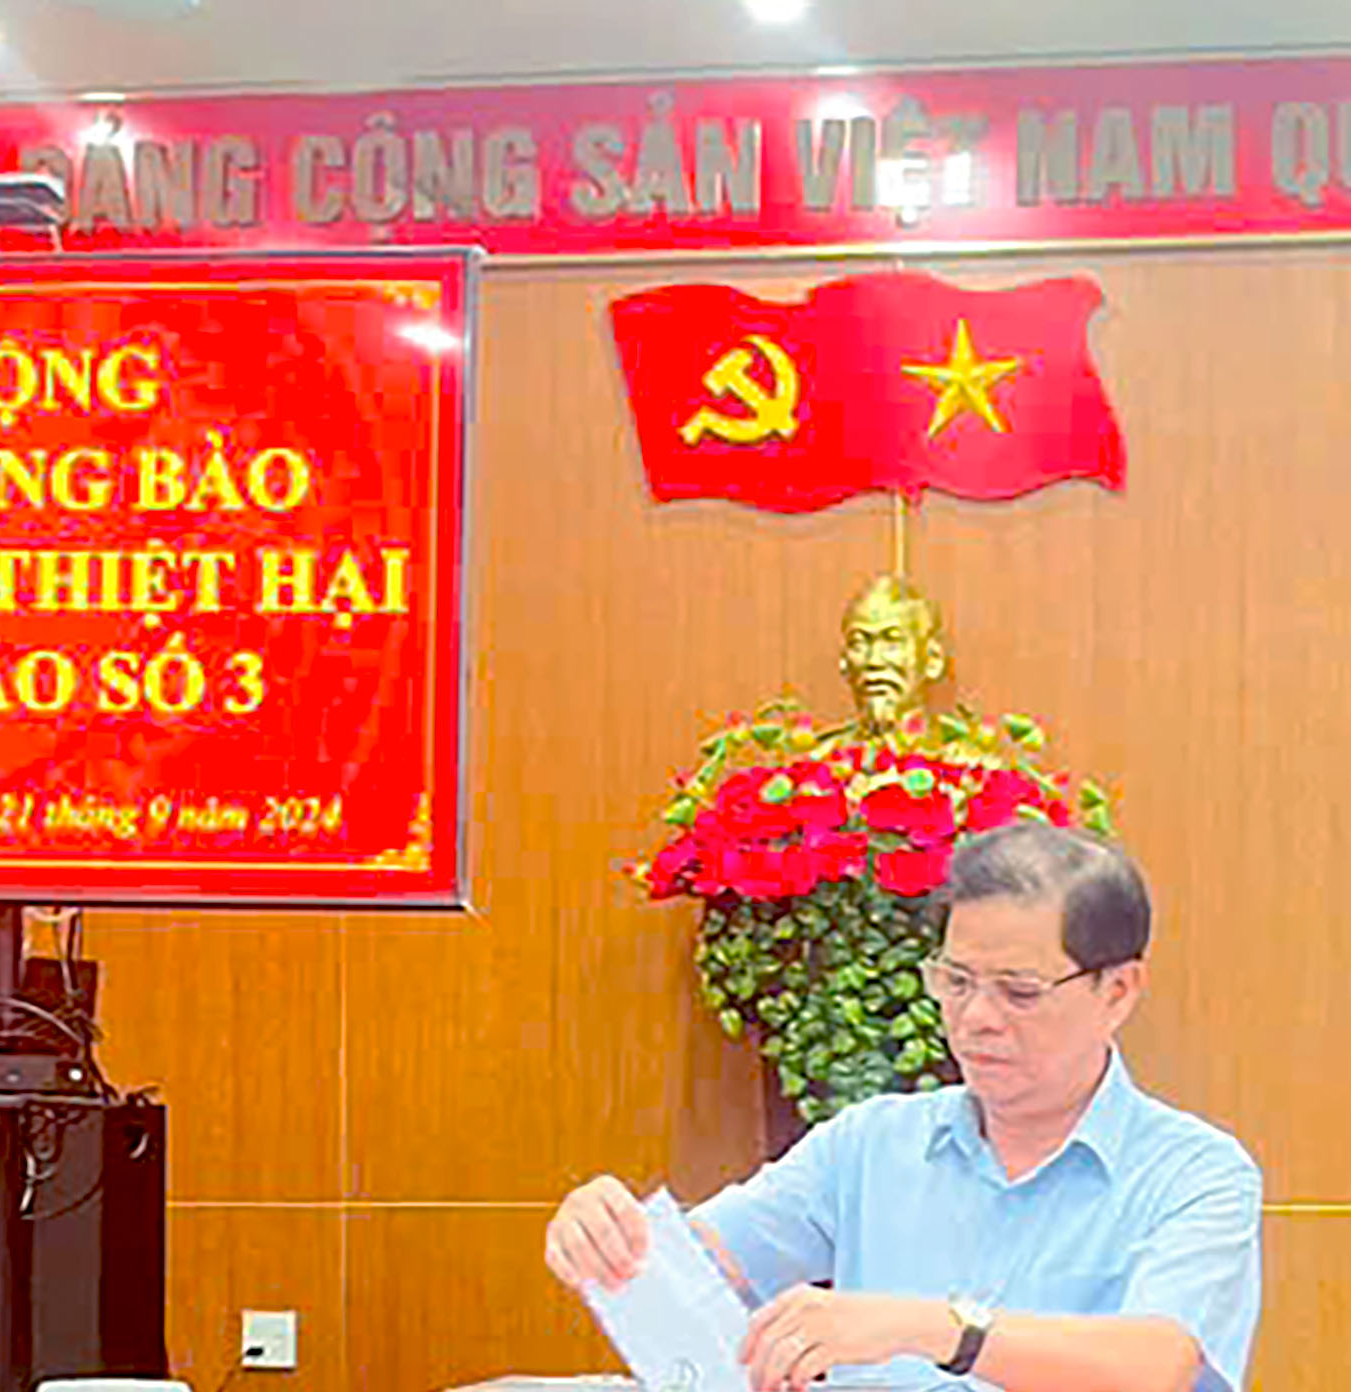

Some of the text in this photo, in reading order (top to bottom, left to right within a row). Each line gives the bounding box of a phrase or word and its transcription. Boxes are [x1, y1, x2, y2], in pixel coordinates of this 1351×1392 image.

[292, 112, 541, 242] CỘNG
[572, 90, 762, 221] SẢN
[796, 94, 991, 228] VIỆT
[1015, 104, 1236, 208] NAM
[136, 430, 311, 511] BÀO
[256, 546, 411, 627] HẠI
[98, 631, 206, 711] SỐ
[224, 651, 266, 713] 3
[149, 794, 172, 828] 9
[258, 793, 343, 836] 2024
